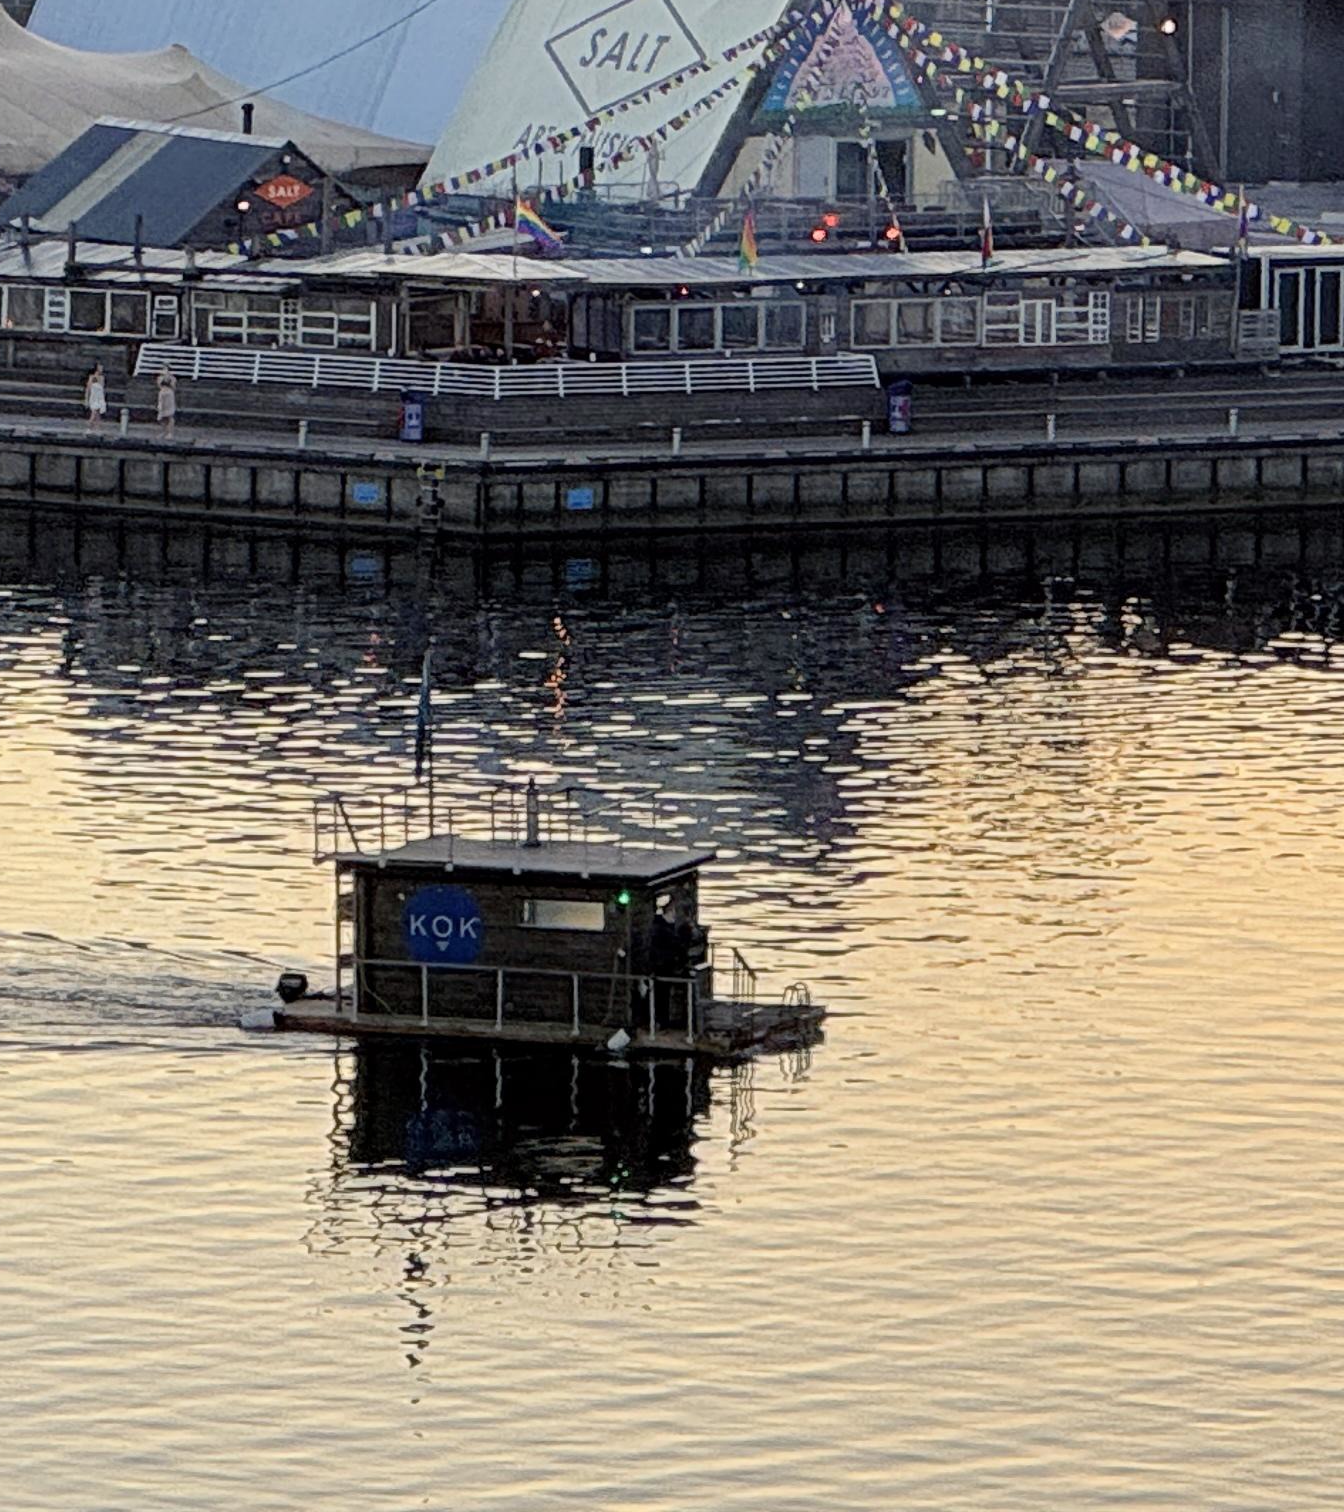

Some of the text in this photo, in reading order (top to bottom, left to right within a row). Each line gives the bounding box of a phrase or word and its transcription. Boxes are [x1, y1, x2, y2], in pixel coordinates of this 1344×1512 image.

[579, 28, 671, 73] SALT
[268, 185, 301, 199] SALT
[410, 915, 481, 938] KOK
